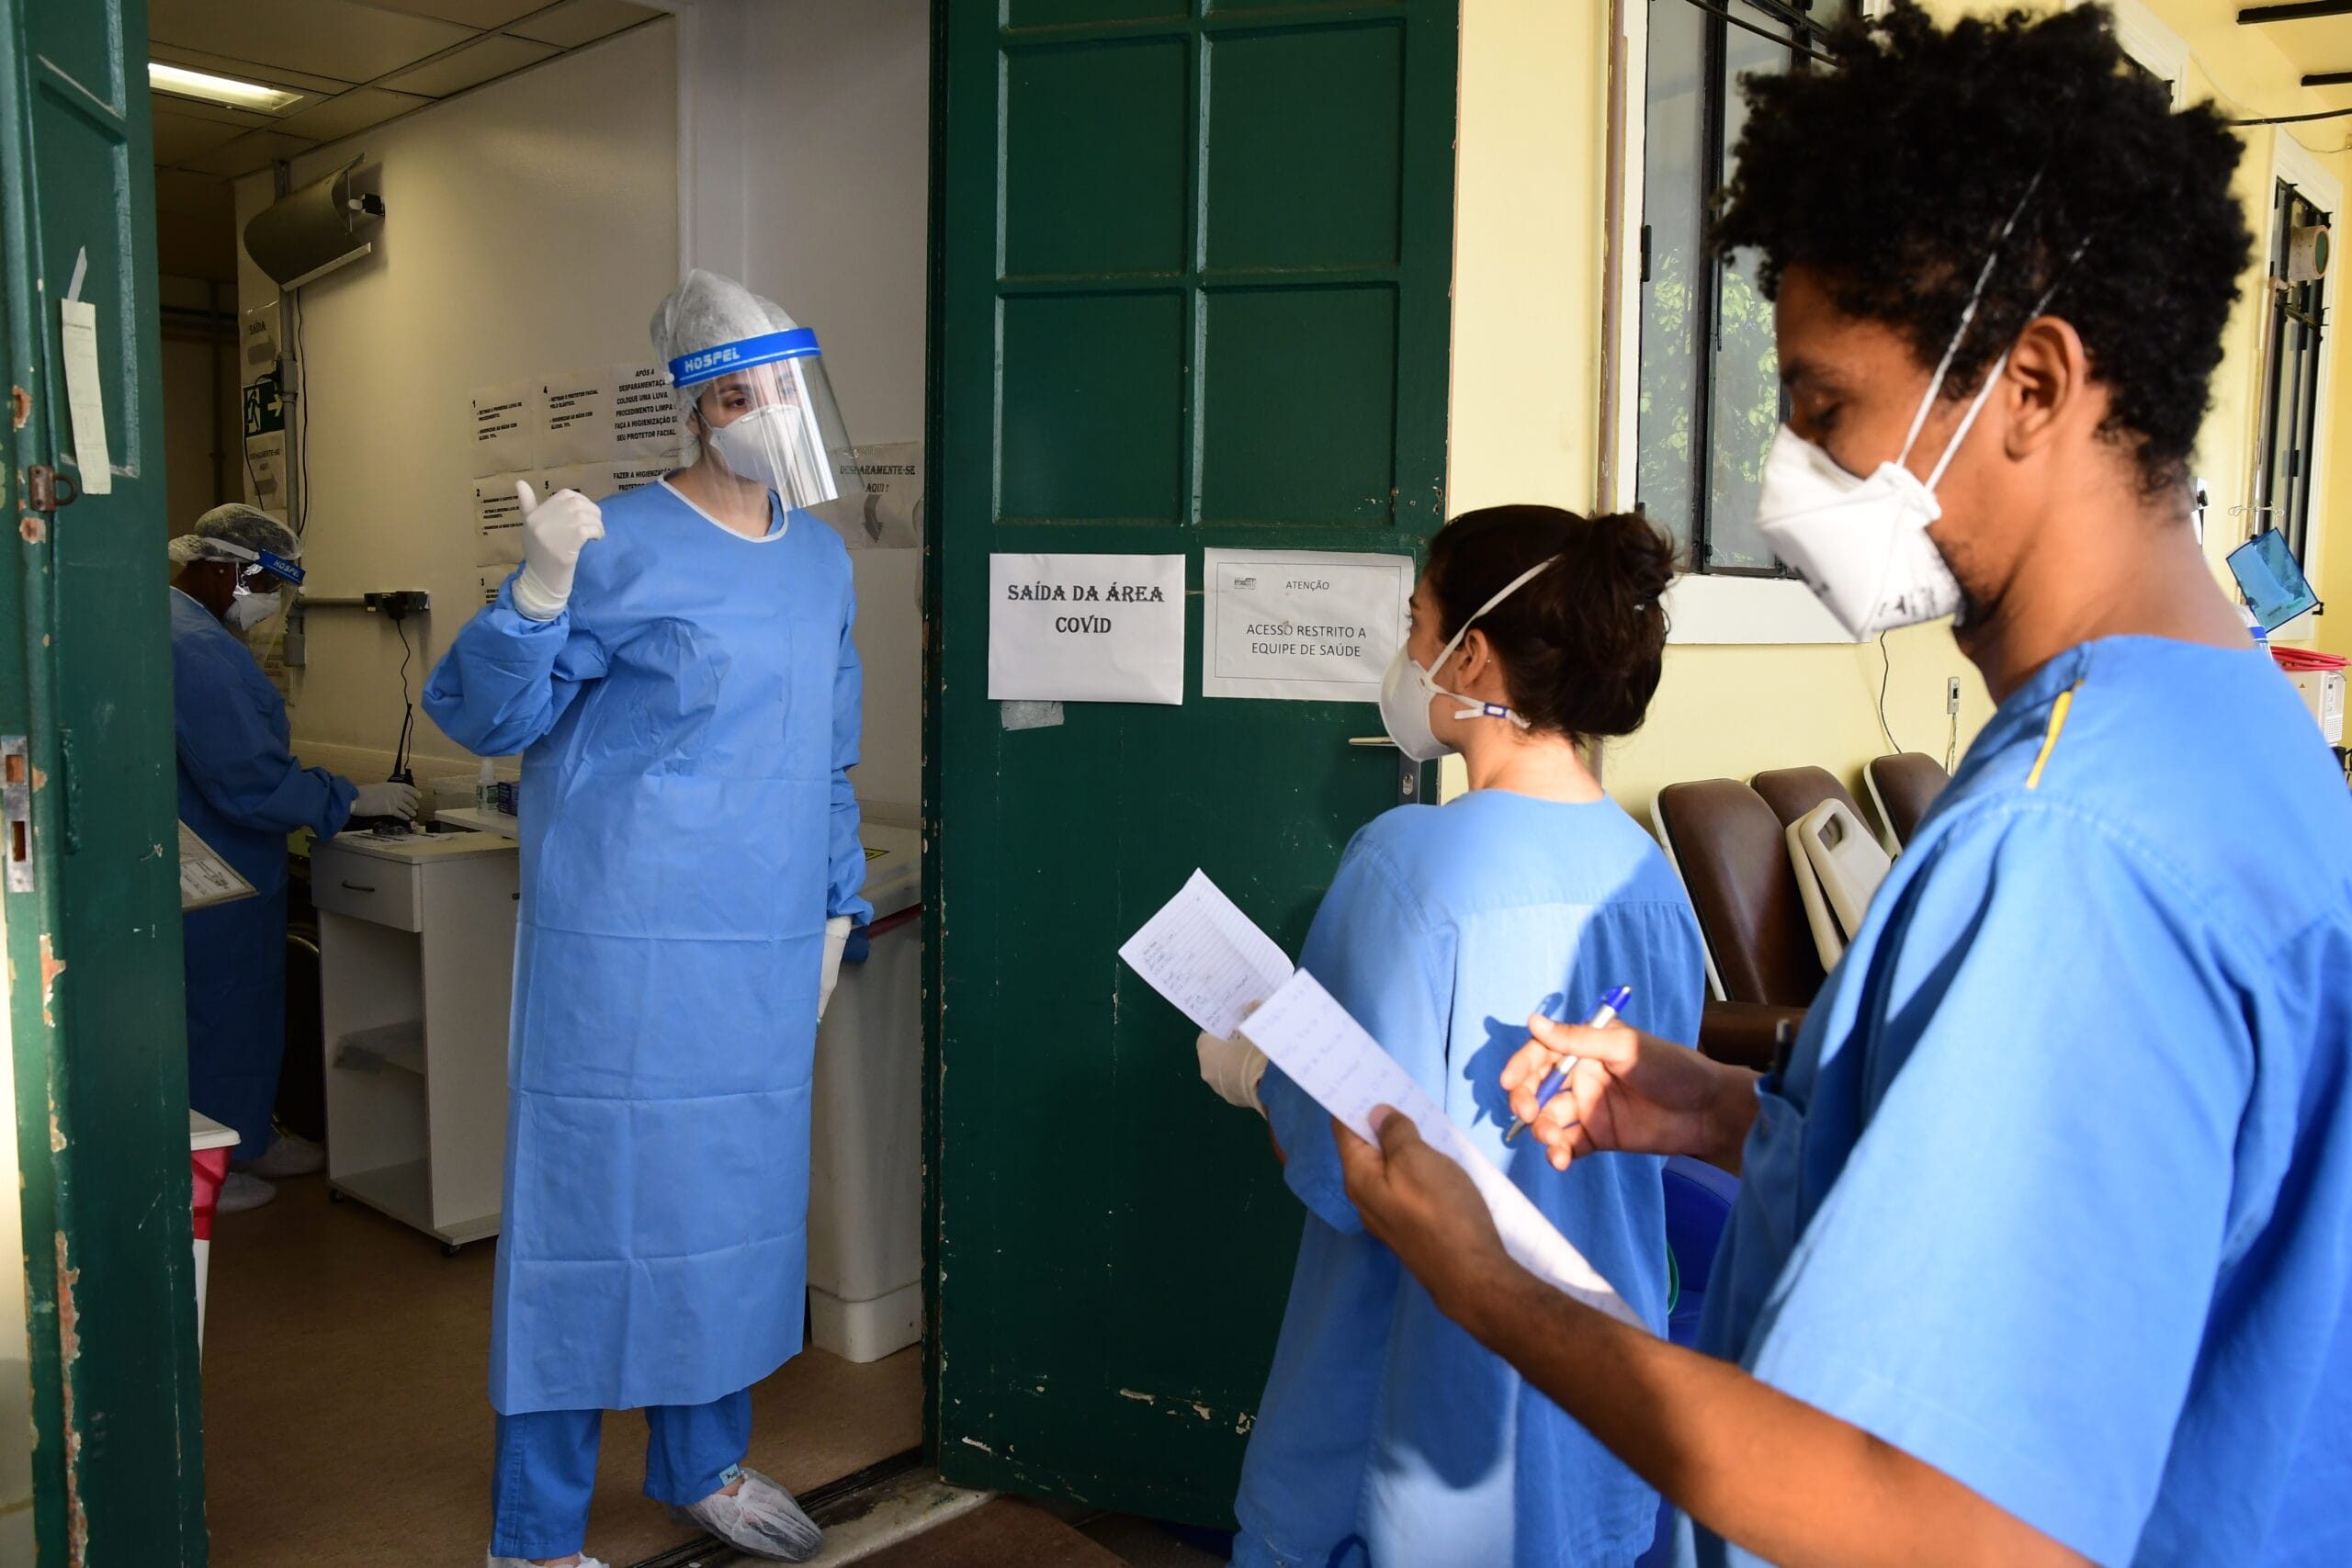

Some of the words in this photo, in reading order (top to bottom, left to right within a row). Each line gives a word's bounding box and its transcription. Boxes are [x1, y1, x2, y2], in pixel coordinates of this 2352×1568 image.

[684, 347, 741, 373] HOSPEL
[544, 386, 548, 394] 4
[618, 378, 670, 392] DESPARAMENTAÇ
[616, 396, 639, 405] COLOQUE
[639, 393, 651, 401] UMA
[652, 391, 669, 400] LUVA
[616, 405, 654, 417] PROCEDIMENTO
[655, 403, 673, 412] LIMPA
[614, 423, 627, 431] FAÇA
[631, 416, 671, 428] HIGIENIZAÇÃO
[627, 431, 656, 441] PROTETOR
[840, 465, 916, 476] DESPARAMENTE-SE
[545, 480, 548, 490] 5
[865, 482, 885, 493] AQUI
[476, 489, 480, 497] 2
[481, 578, 484, 586] 3
[1285, 580, 1330, 592] ATENÇÃO
[1007, 581, 1067, 602] SAÍDA
[1072, 585, 1100, 602] DA
[1105, 581, 1165, 603] ÁREA
[1056, 614, 1112, 634] COVID
[1246, 624, 1294, 637] ACESSO
[1297, 625, 1354, 638] RESTRITO
[1358, 626, 1367, 638] A
[1251, 642, 1296, 657] EQUIPE
[1300, 644, 1316, 656] DE
[1319, 643, 1362, 657] SAÚDE
